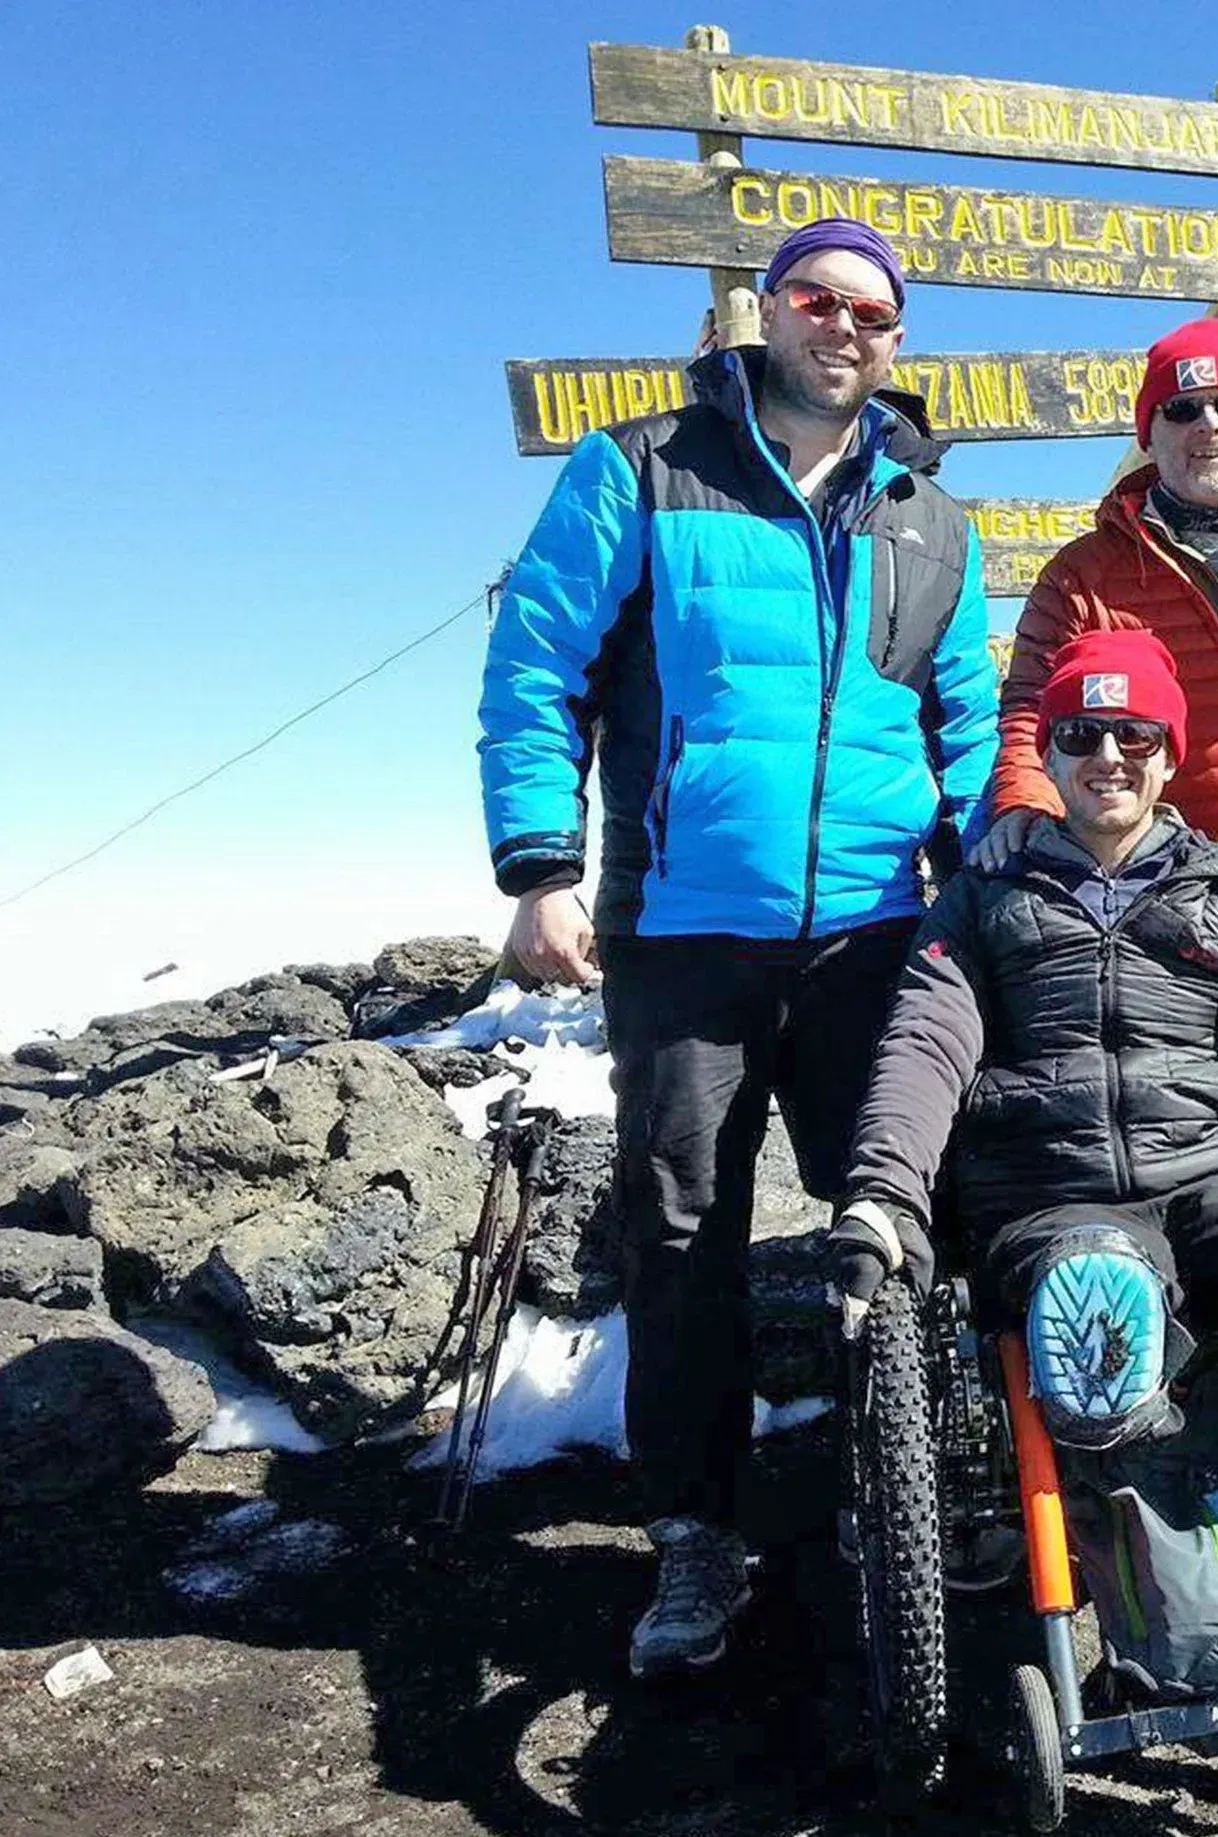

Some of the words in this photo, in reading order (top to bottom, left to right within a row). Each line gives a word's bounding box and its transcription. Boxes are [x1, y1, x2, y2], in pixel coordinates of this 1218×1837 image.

[711, 68, 907, 129] MOUNT
[893, 246, 938, 272] OU
[955, 249, 1031, 279] ARE
[1049, 256, 1124, 286] NOW
[1138, 264, 1179, 291] AT
[1063, 357, 1147, 424] 589
[966, 506, 1097, 541] IGHES
